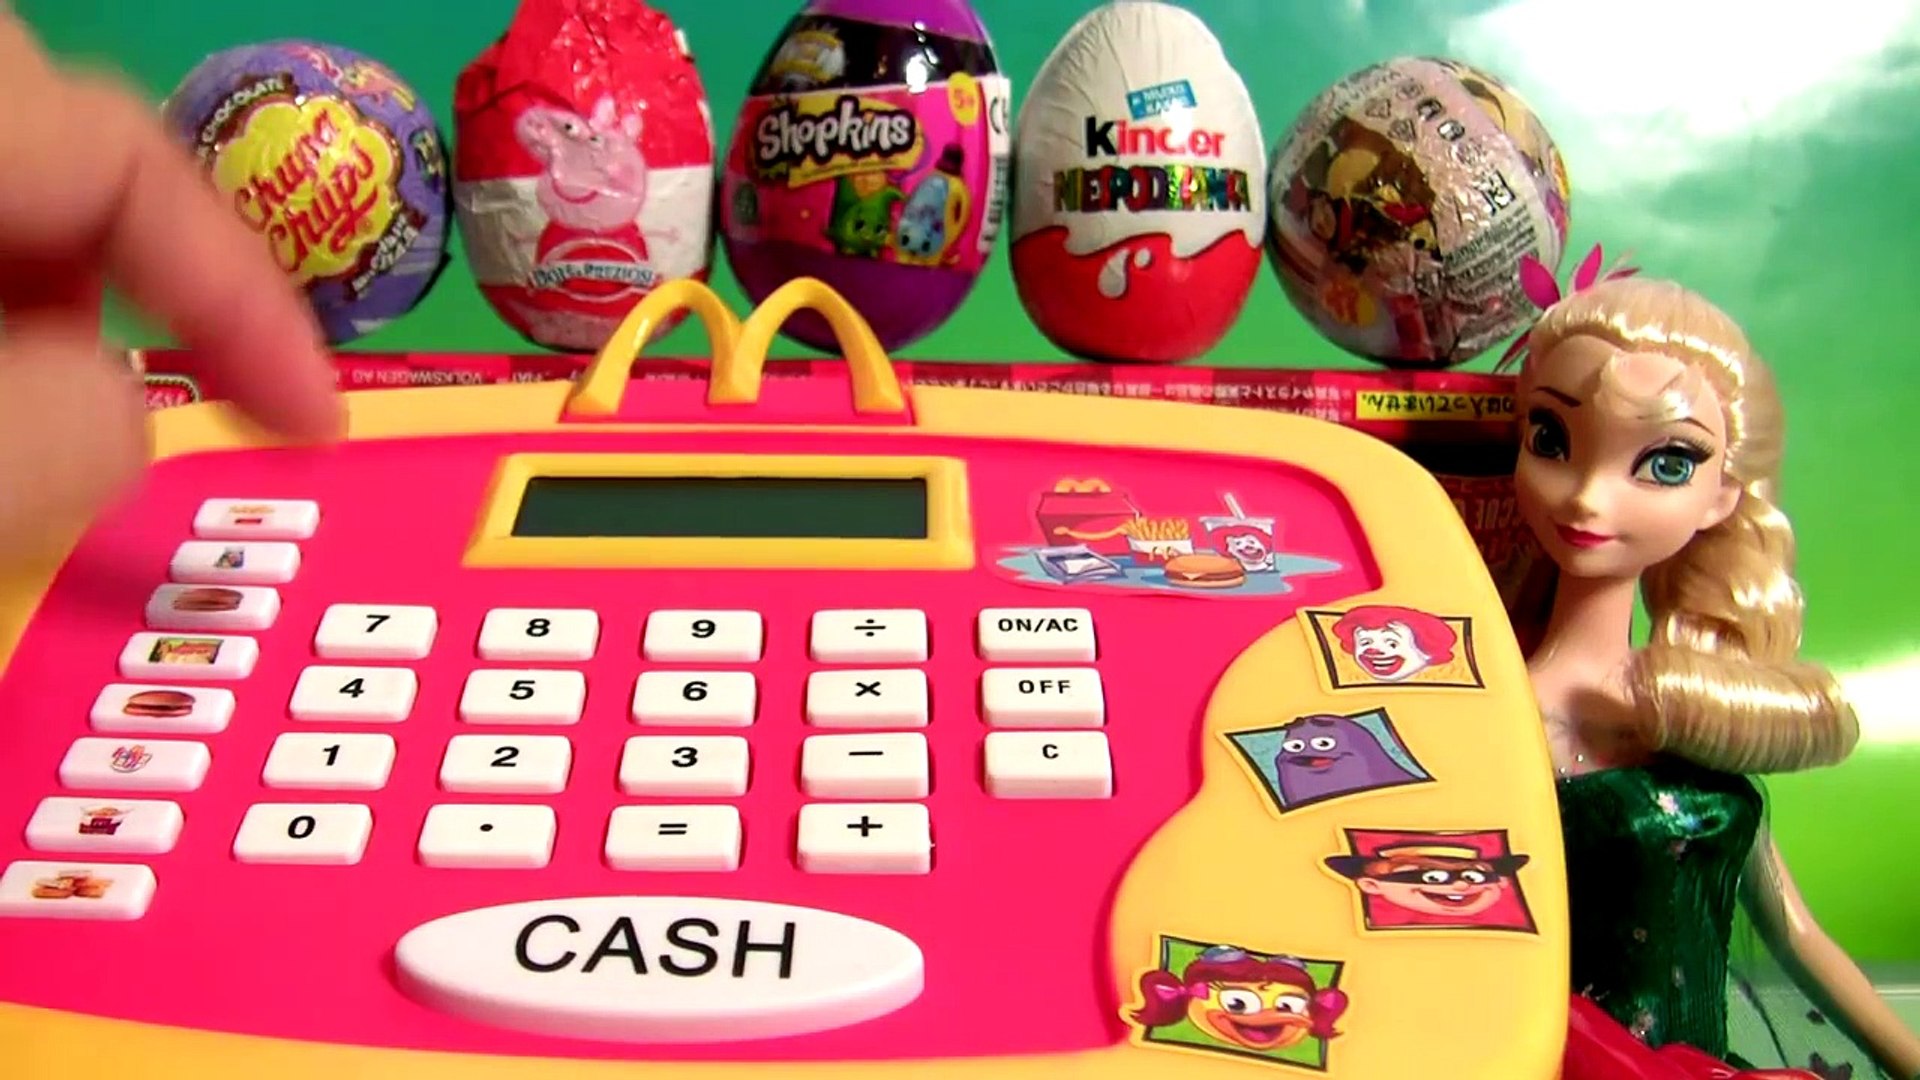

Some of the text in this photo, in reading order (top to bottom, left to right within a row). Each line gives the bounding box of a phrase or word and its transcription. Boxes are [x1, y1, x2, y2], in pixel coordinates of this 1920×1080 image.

[200, 77, 285, 143] CHOCOLATE
[757, 98, 912, 161] Shopkins
[235, 108, 341, 236] Chupa
[268, 145, 379, 273] Chups
[376, 369, 482, 385] VOLKSWAGEN
[367, 615, 389, 632] 7
[526, 619, 550, 637] 8
[692, 620, 715, 638] 9
[998, 619, 1077, 632] ON/AC
[340, 678, 364, 698] 4
[510, 681, 535, 700] 5
[683, 681, 707, 701] 6
[1019, 680, 1069, 693] OFF
[324, 745, 339, 765] 1
[491, 747, 519, 767] 2
[672, 747, 697, 767] 3
[1043, 745, 1058, 758] C
[288, 816, 315, 839] 0
[516, 915, 795, 978] CASH
